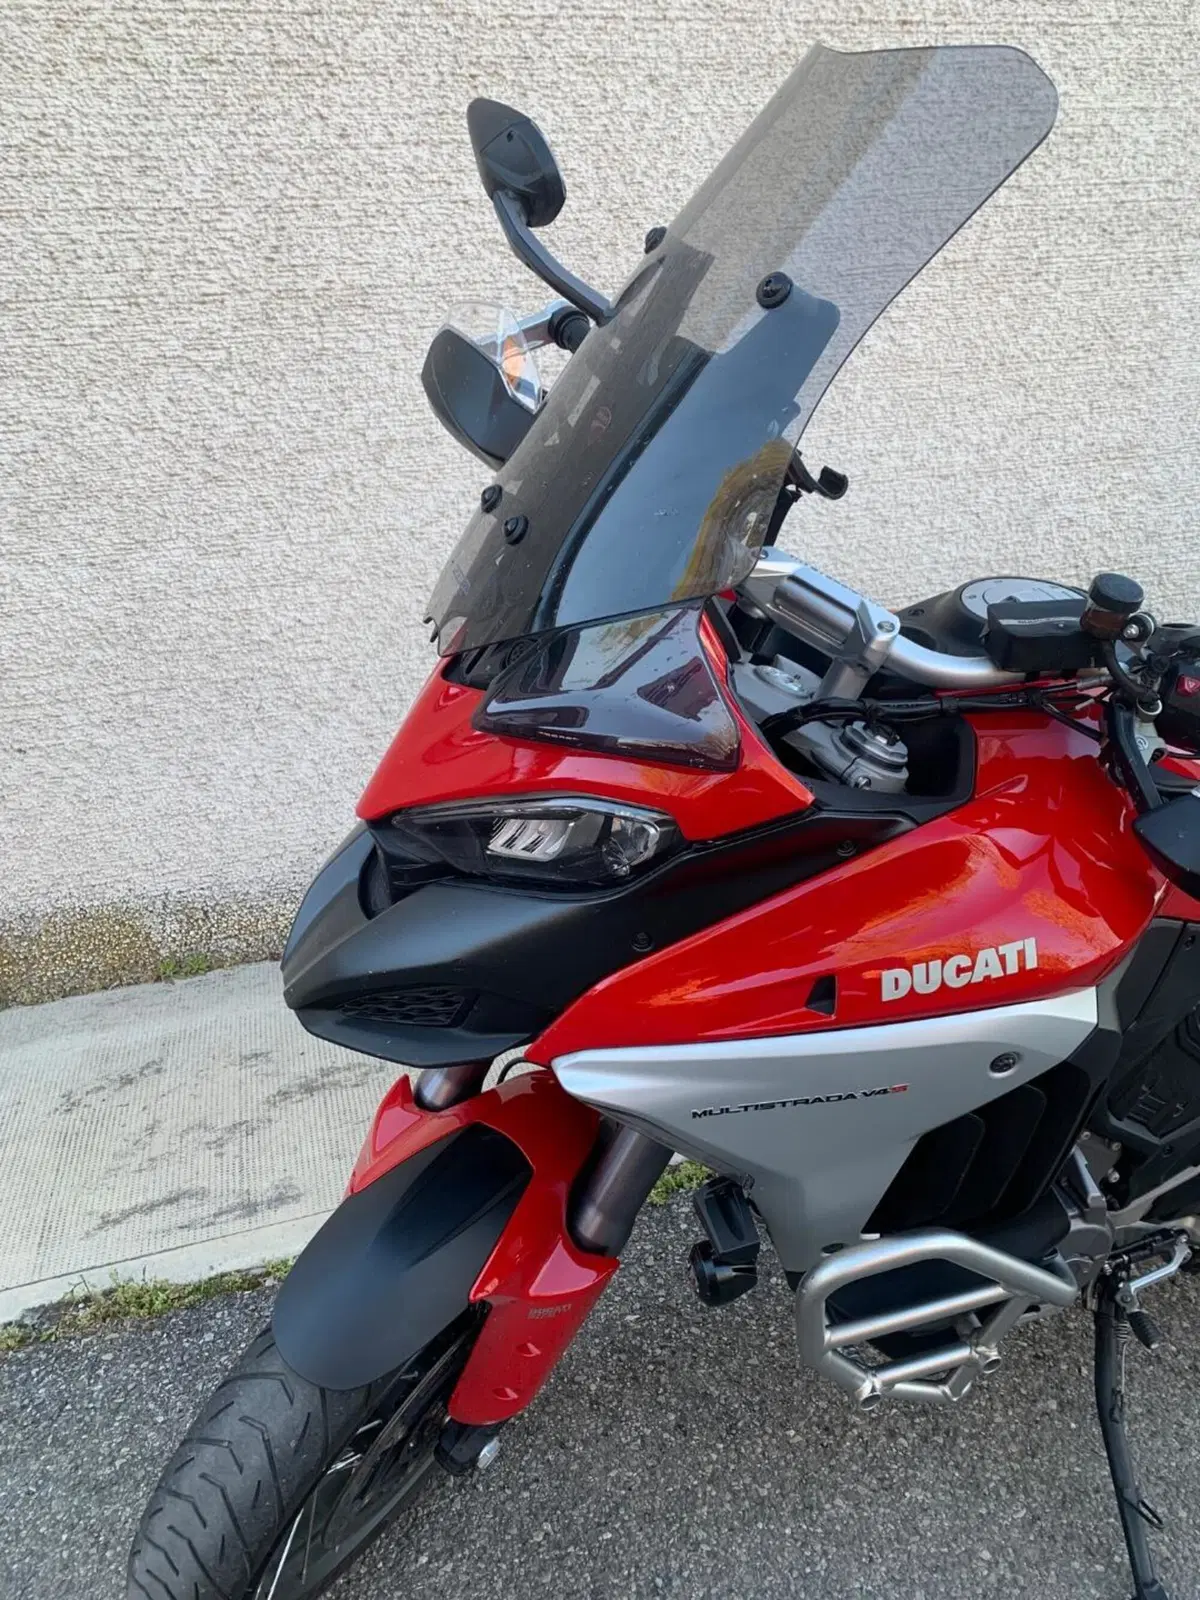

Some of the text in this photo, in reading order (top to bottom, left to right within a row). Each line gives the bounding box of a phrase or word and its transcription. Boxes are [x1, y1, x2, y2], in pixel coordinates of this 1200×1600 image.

[881, 937, 1038, 1002] DUCATI
[691, 1083, 909, 1119] MULTISTRADA V4S
